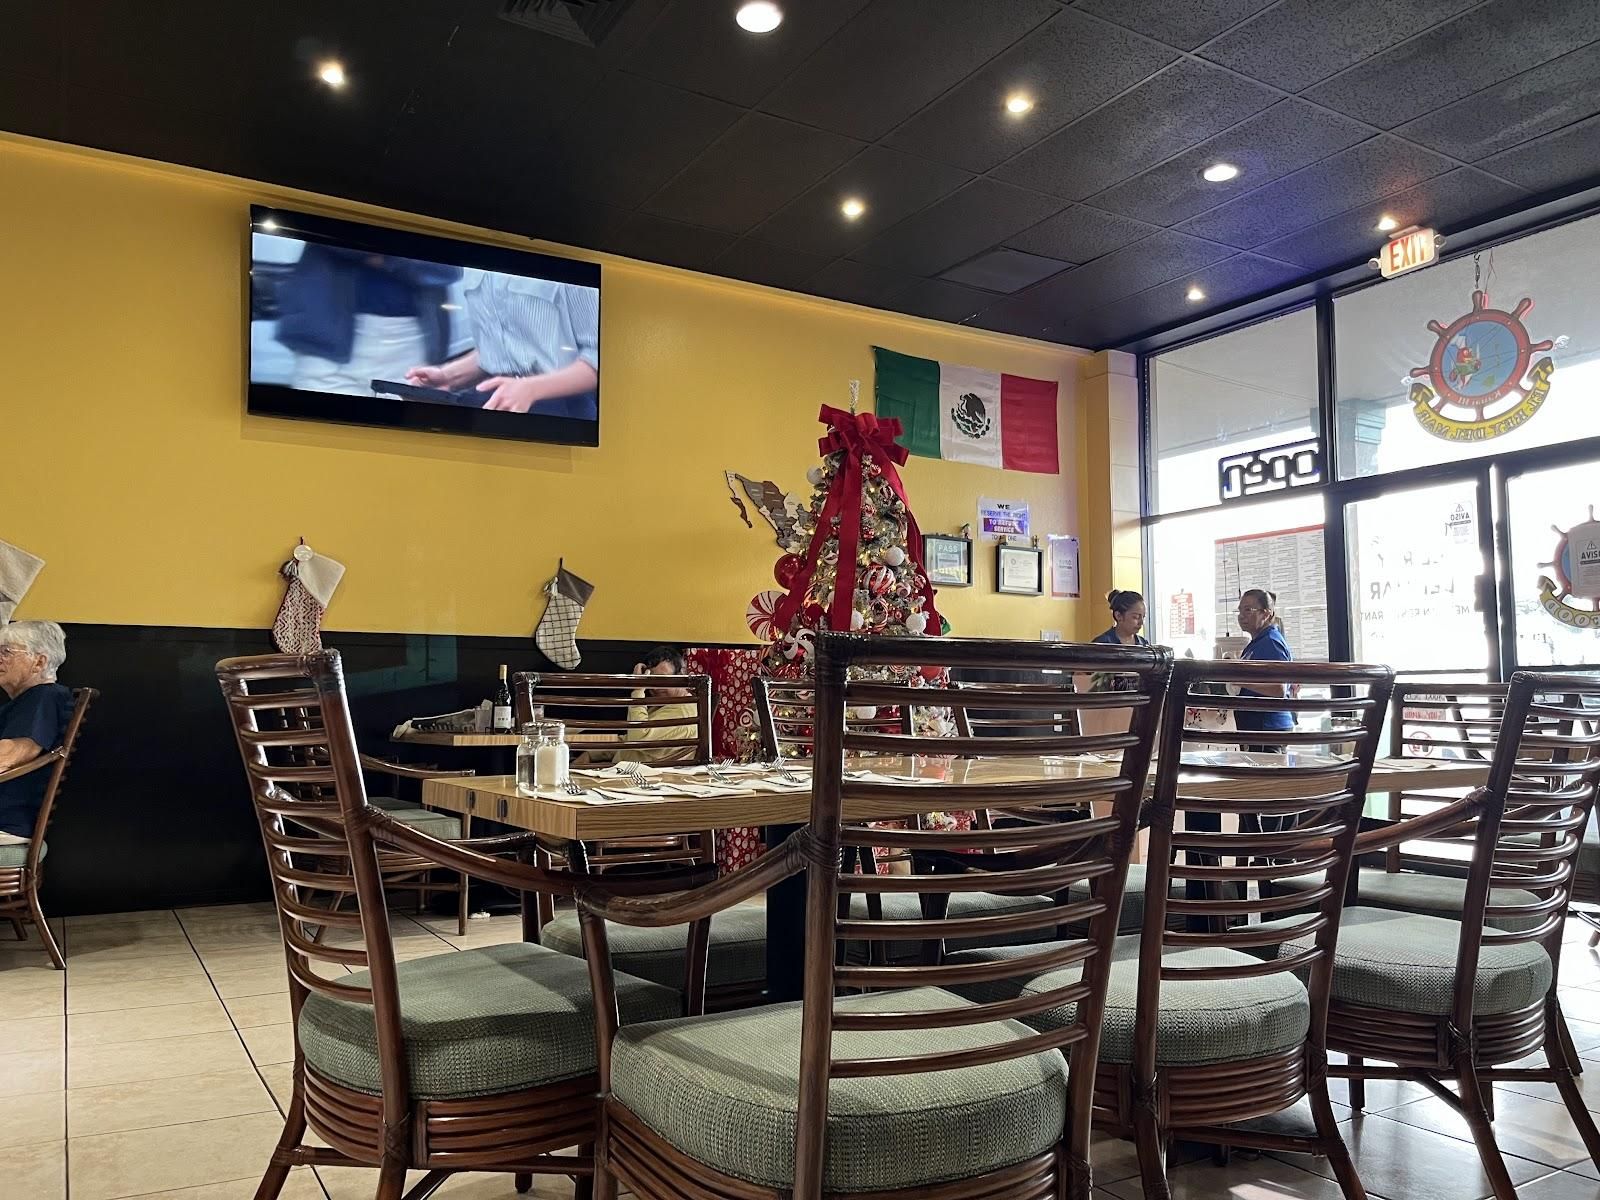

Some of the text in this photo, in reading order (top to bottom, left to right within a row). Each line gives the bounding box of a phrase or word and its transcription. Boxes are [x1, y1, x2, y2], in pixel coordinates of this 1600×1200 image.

[1389, 232, 1425, 272] EXIT
[938, 544, 958, 553] PASS
[1581, 550, 1600, 560] AVIS
